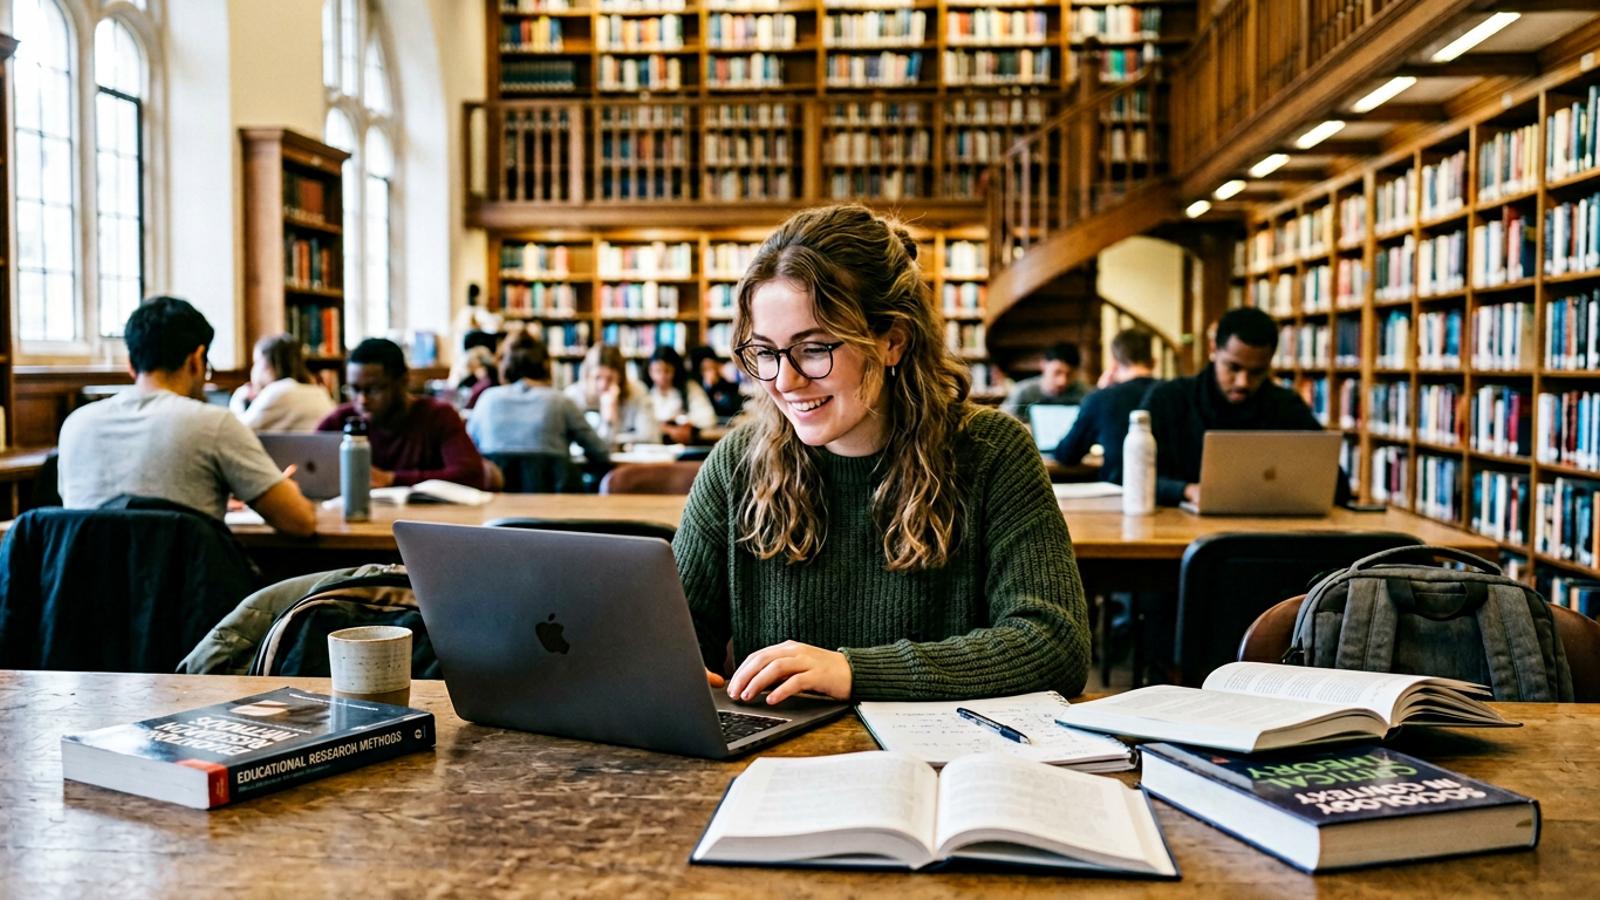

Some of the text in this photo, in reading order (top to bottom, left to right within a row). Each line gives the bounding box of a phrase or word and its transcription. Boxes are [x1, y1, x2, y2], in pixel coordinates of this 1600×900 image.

[237, 756, 306, 784] EDUCATIONAL
[309, 742, 358, 765] RESEARCH
[360, 731, 402, 751] METHODS
[1247, 754, 1397, 779] THEORY
